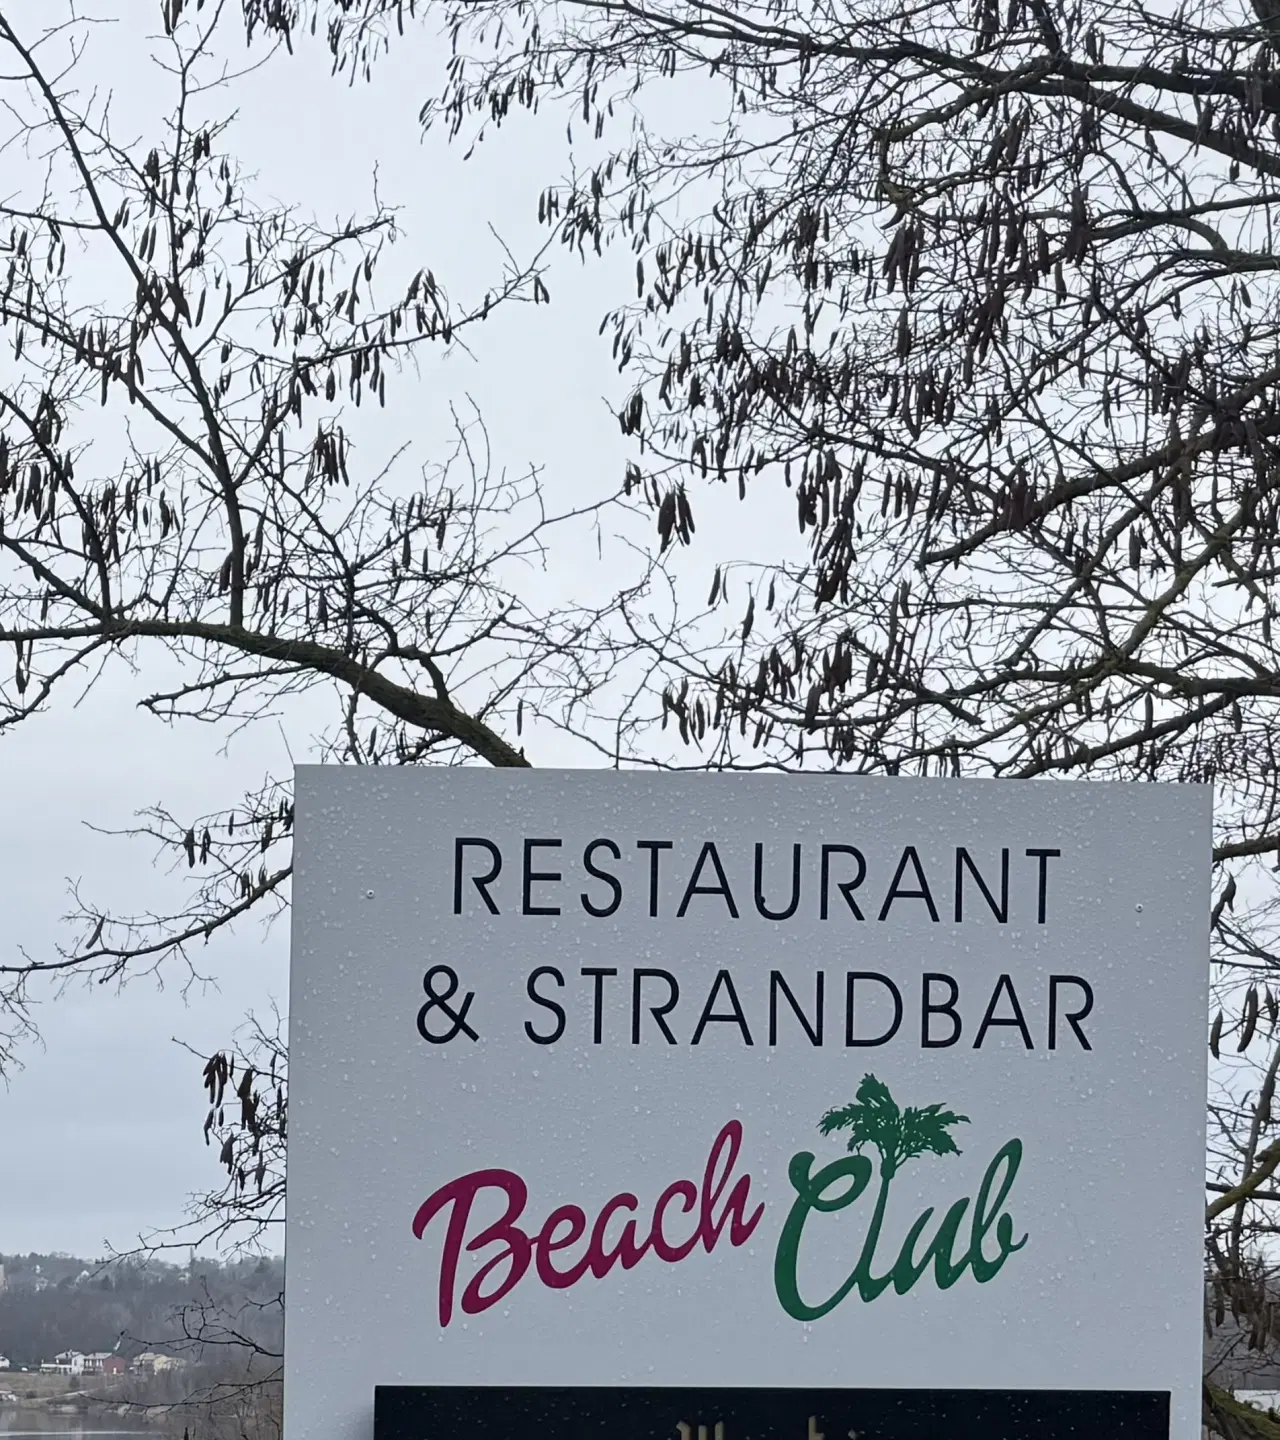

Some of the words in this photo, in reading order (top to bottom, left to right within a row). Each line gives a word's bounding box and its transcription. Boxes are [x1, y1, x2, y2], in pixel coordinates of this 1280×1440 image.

[453, 837, 1062, 925] RESTAURANT
[416, 964, 480, 1046] &
[524, 965, 1095, 1051] STRANDBAR
[412, 1119, 765, 1328] Beach
[773, 1136, 1029, 1322] Club
